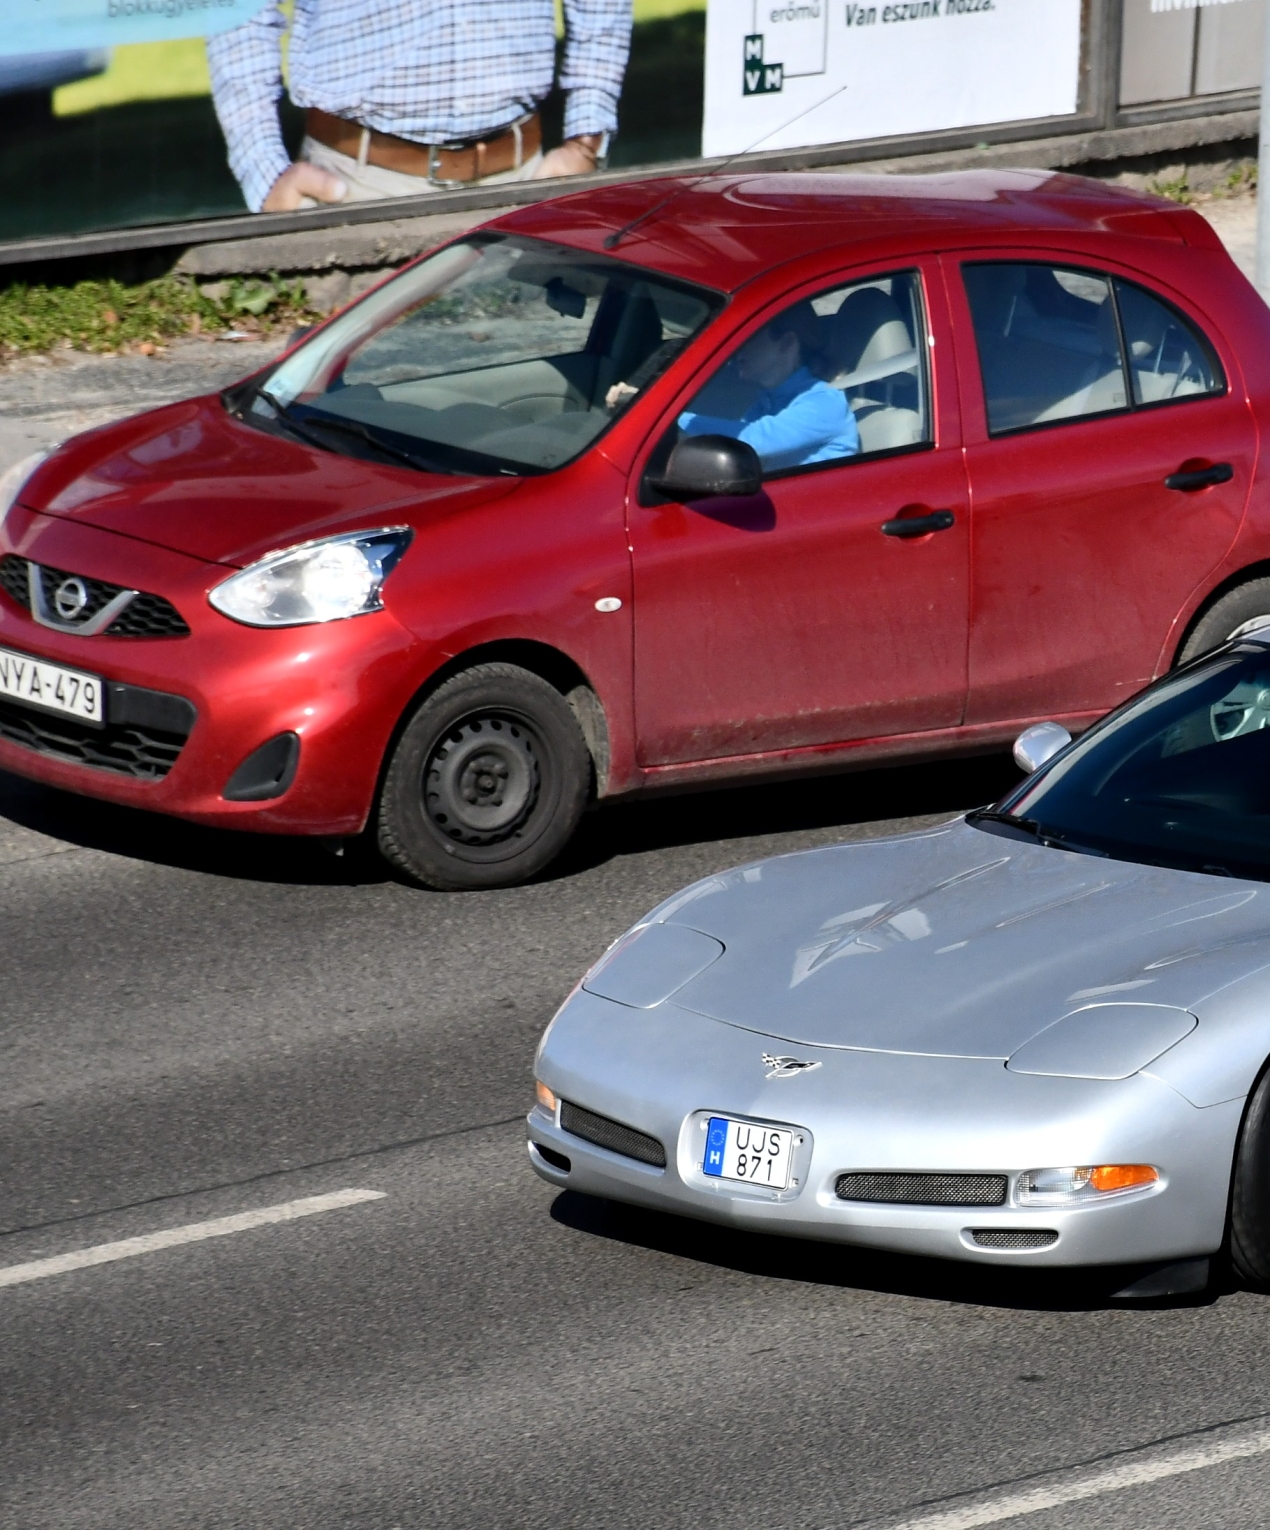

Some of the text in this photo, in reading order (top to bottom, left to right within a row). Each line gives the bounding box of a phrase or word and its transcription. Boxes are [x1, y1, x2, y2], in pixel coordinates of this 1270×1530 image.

[845, 3, 877, 27] Van
[0, 657, 95, 715] NYA-479
[736, 1126, 781, 1157] UJS
[709, 1150, 721, 1165] H
[736, 1153, 773, 1182] 871
